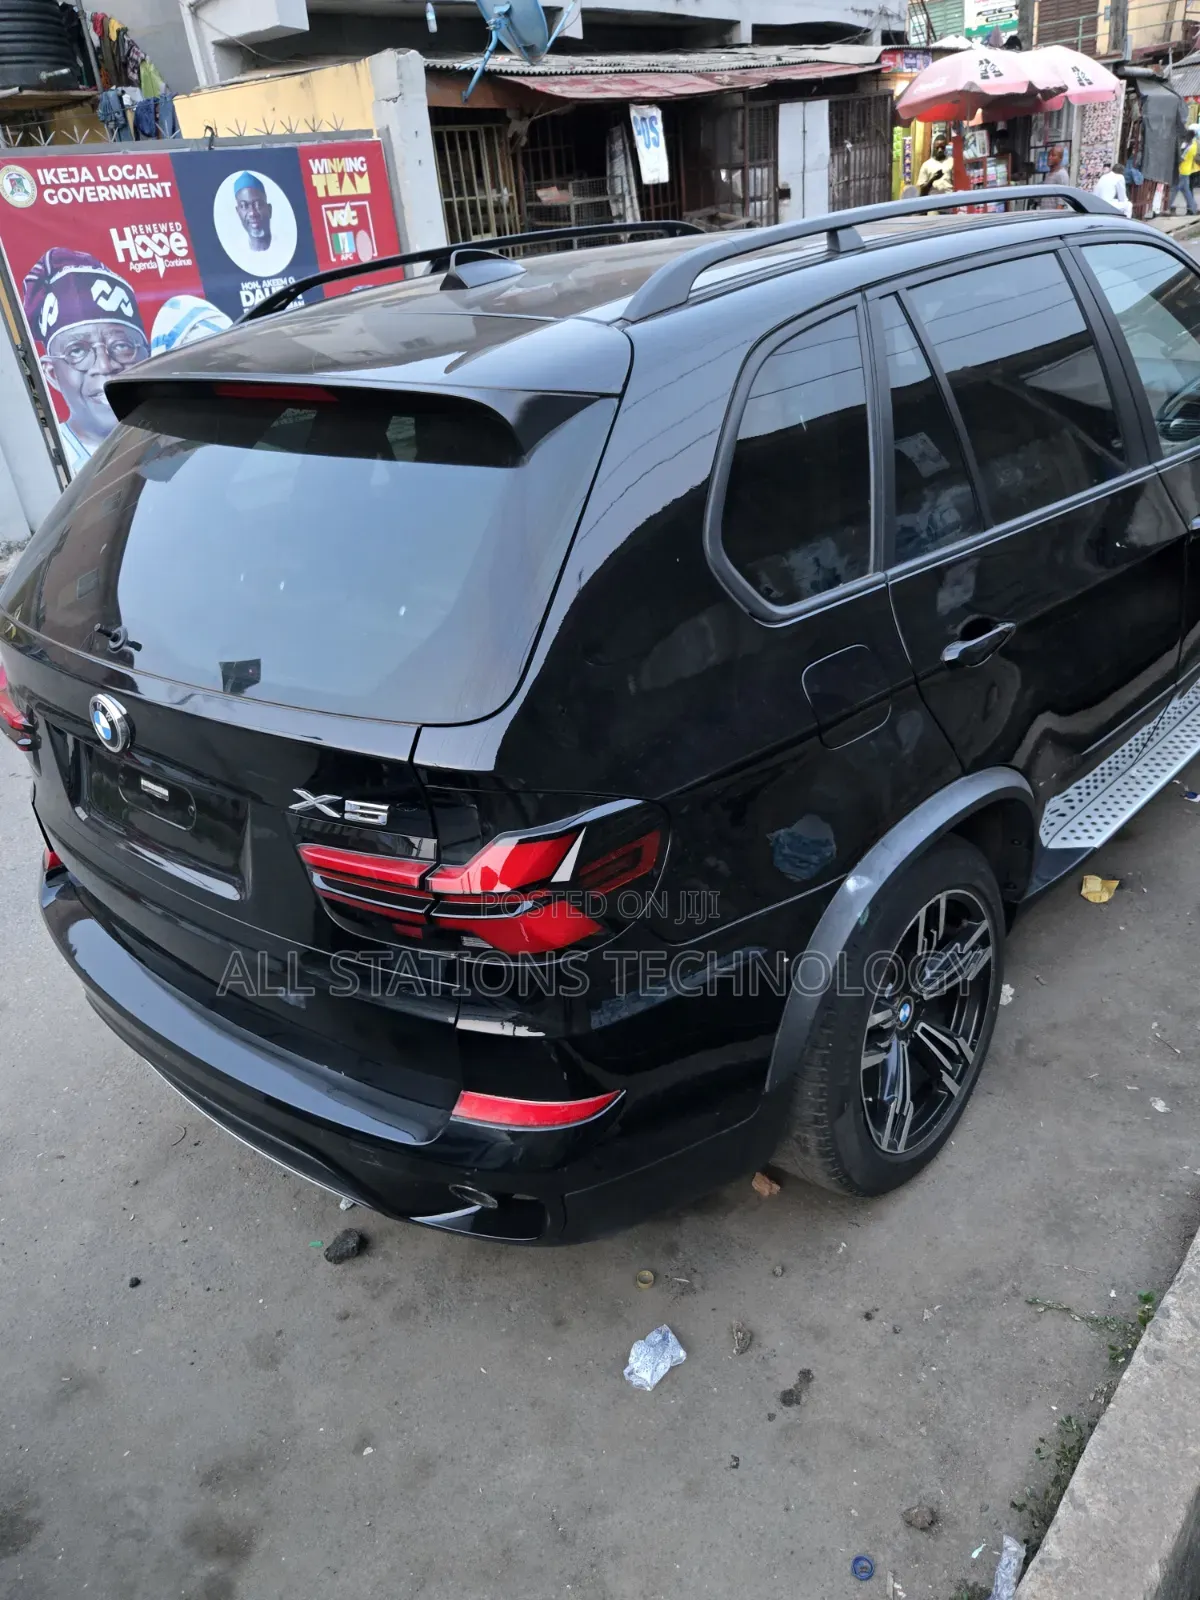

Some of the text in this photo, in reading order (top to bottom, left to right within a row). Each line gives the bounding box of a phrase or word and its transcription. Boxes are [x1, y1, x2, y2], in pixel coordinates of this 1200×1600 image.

[36, 163, 158, 185] IKEJA LOCAL
[308, 156, 368, 174] WINNING
[43, 182, 172, 205] GOVERNMENT
[311, 171, 371, 198] TEAM
[131, 221, 182, 235] RENEWED
[109, 224, 189, 279] Hope
[129, 258, 192, 273] Agenda Continue
[288, 787, 390, 826] X5
